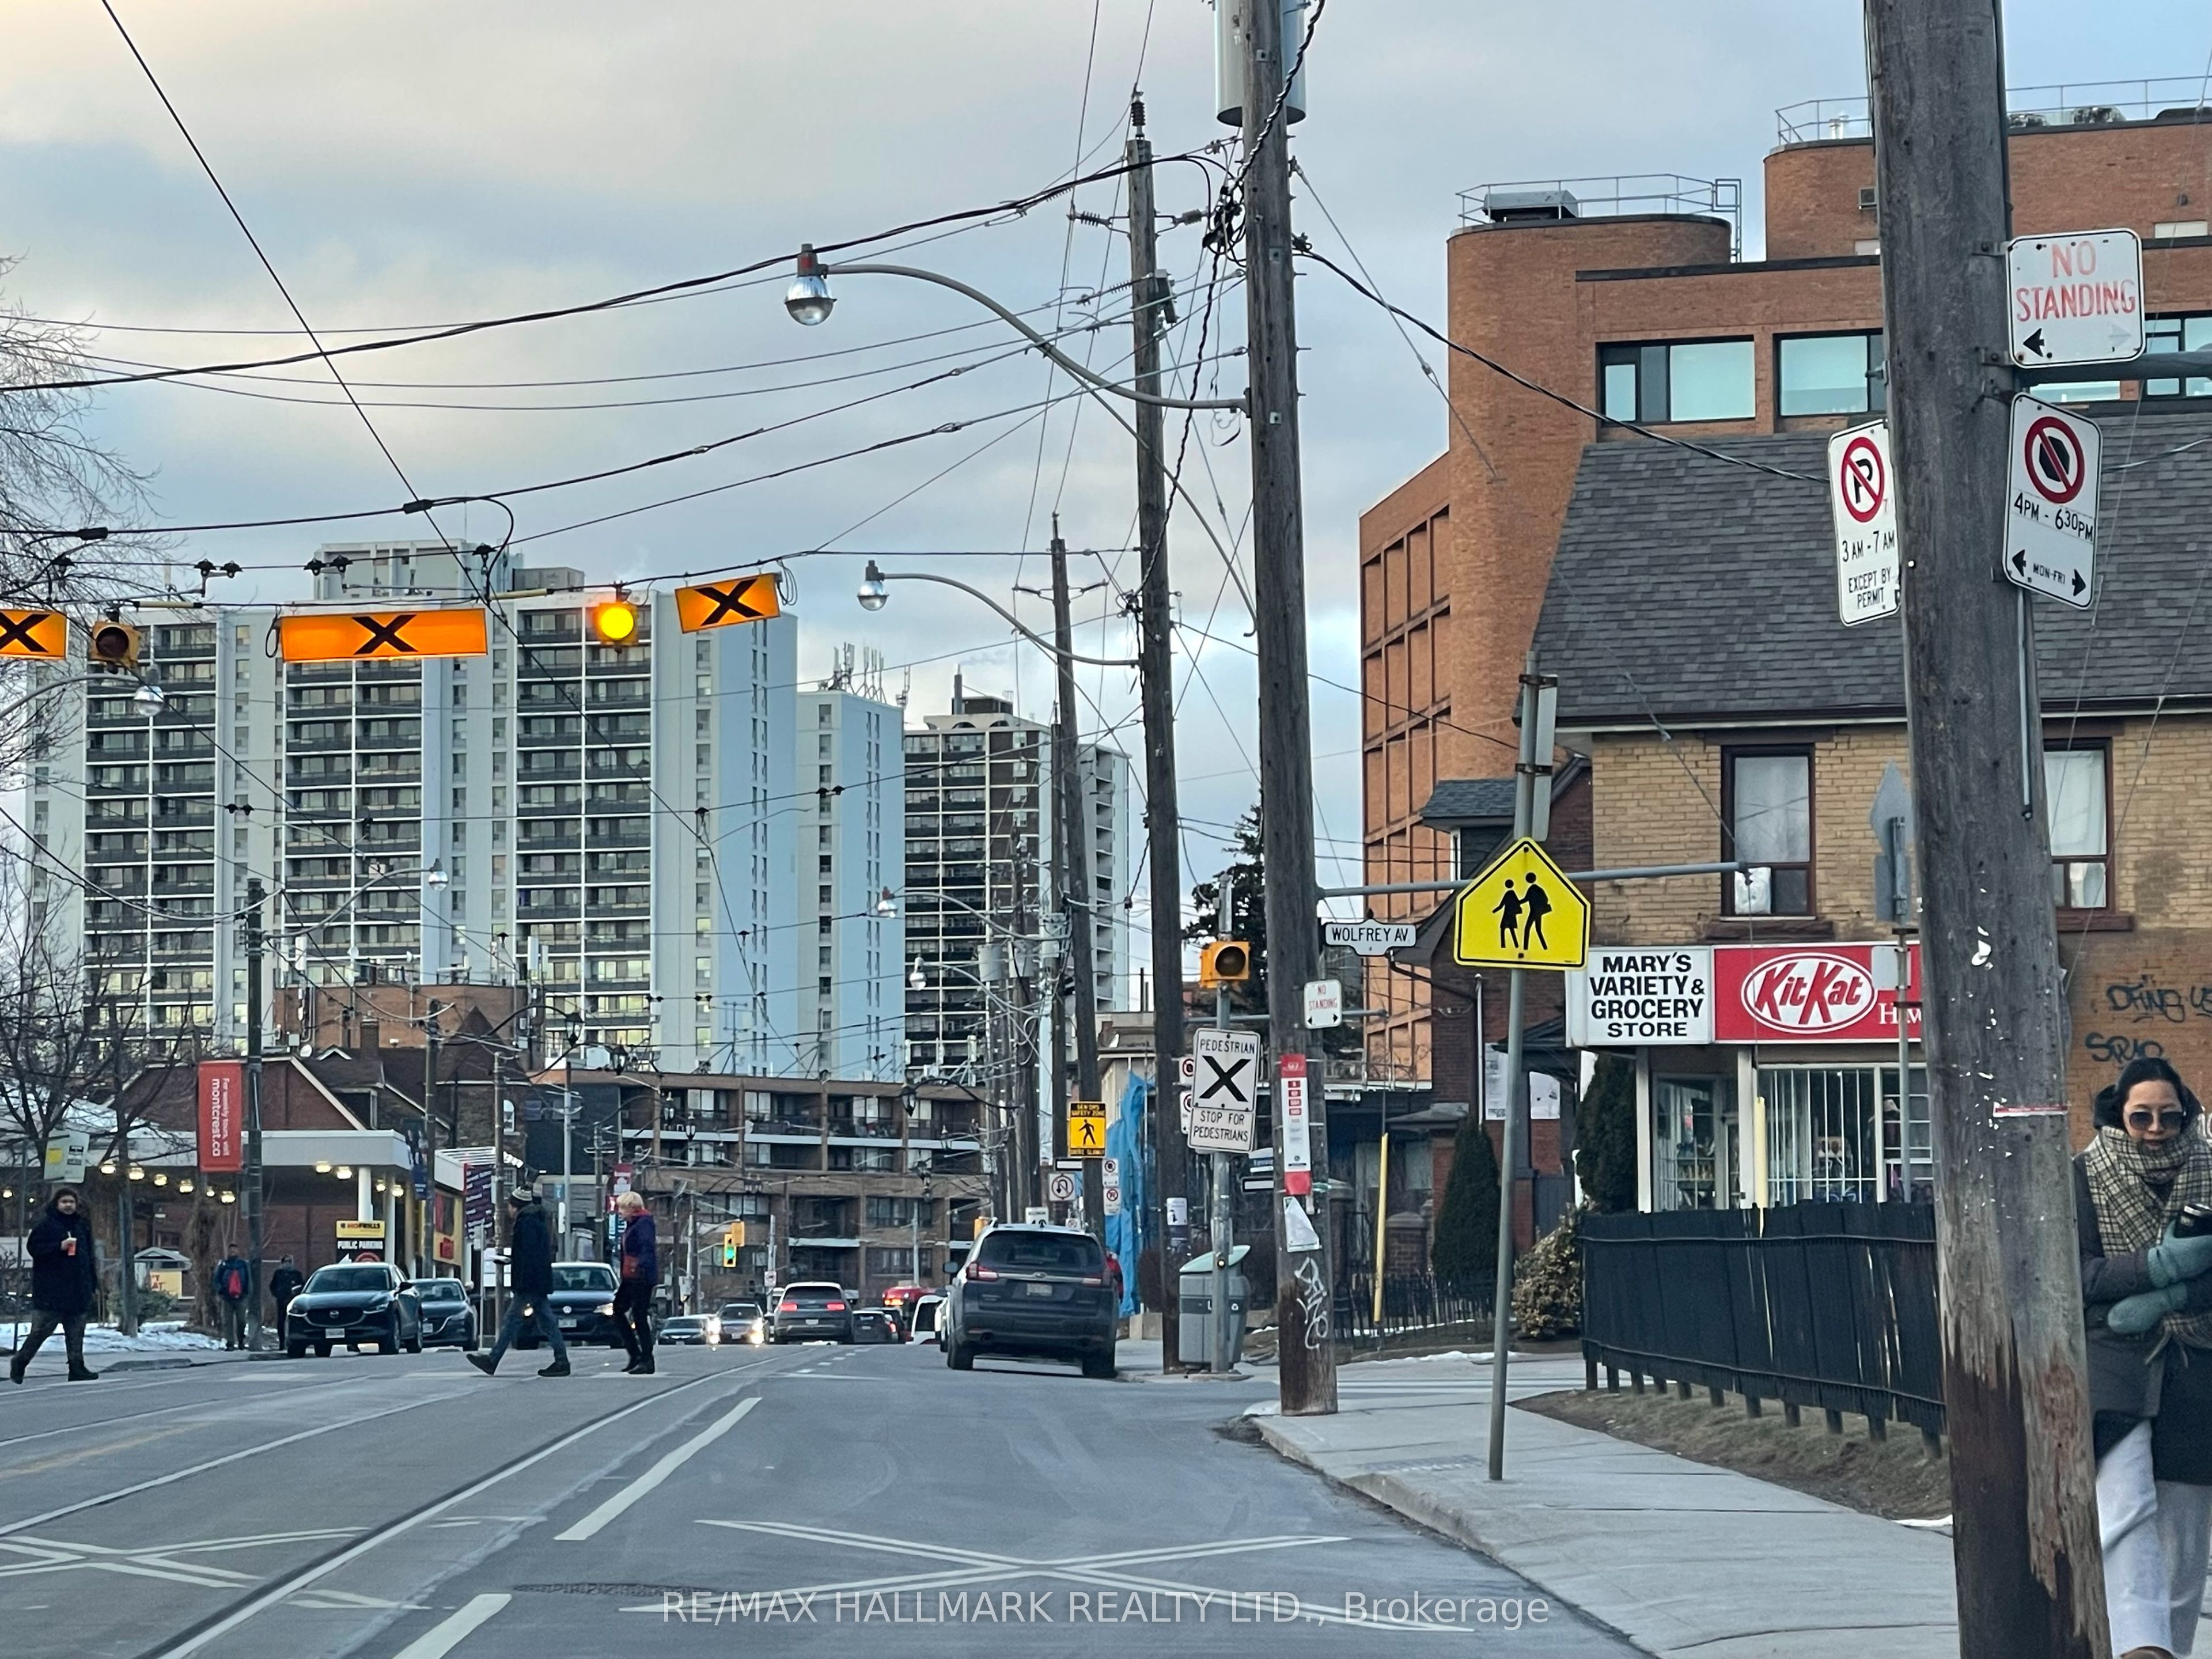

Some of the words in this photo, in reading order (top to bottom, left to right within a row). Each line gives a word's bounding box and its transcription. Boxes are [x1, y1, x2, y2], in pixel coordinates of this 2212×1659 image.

[2052, 241, 2097, 278] NO
[2016, 279, 2136, 321] STANDING
[1842, 540, 1849, 562] 3
[1851, 540, 1864, 560] AM
[1873, 531, 1880, 554] 7
[1883, 530, 1895, 551] AM
[1849, 570, 1877, 593] EXCEPT
[1881, 566, 1891, 585] BY
[1857, 588, 1884, 609] PERMIT
[1332, 927, 1391, 942] WOLFREY
[1603, 952, 1692, 972] MARY'S
[1317, 984, 1326, 995] NO
[1589, 975, 1688, 996] VARIETY
[1691, 979, 1705, 995] &
[1754, 961, 1863, 1025] KitKat
[1308, 998, 1338, 1012] STANDING
[1591, 998, 1703, 1019] GROCERY
[1607, 1022, 1687, 1037] STORE
[1200, 1039, 1255, 1054] PEDESTRIAN
[212, 1078, 221, 1157] montcrest.ca
[1200, 1110, 1222, 1123] STOP
[1228, 1113, 1244, 1126] FOR
[1194, 1126, 1248, 1142] PEDESTRIANS
